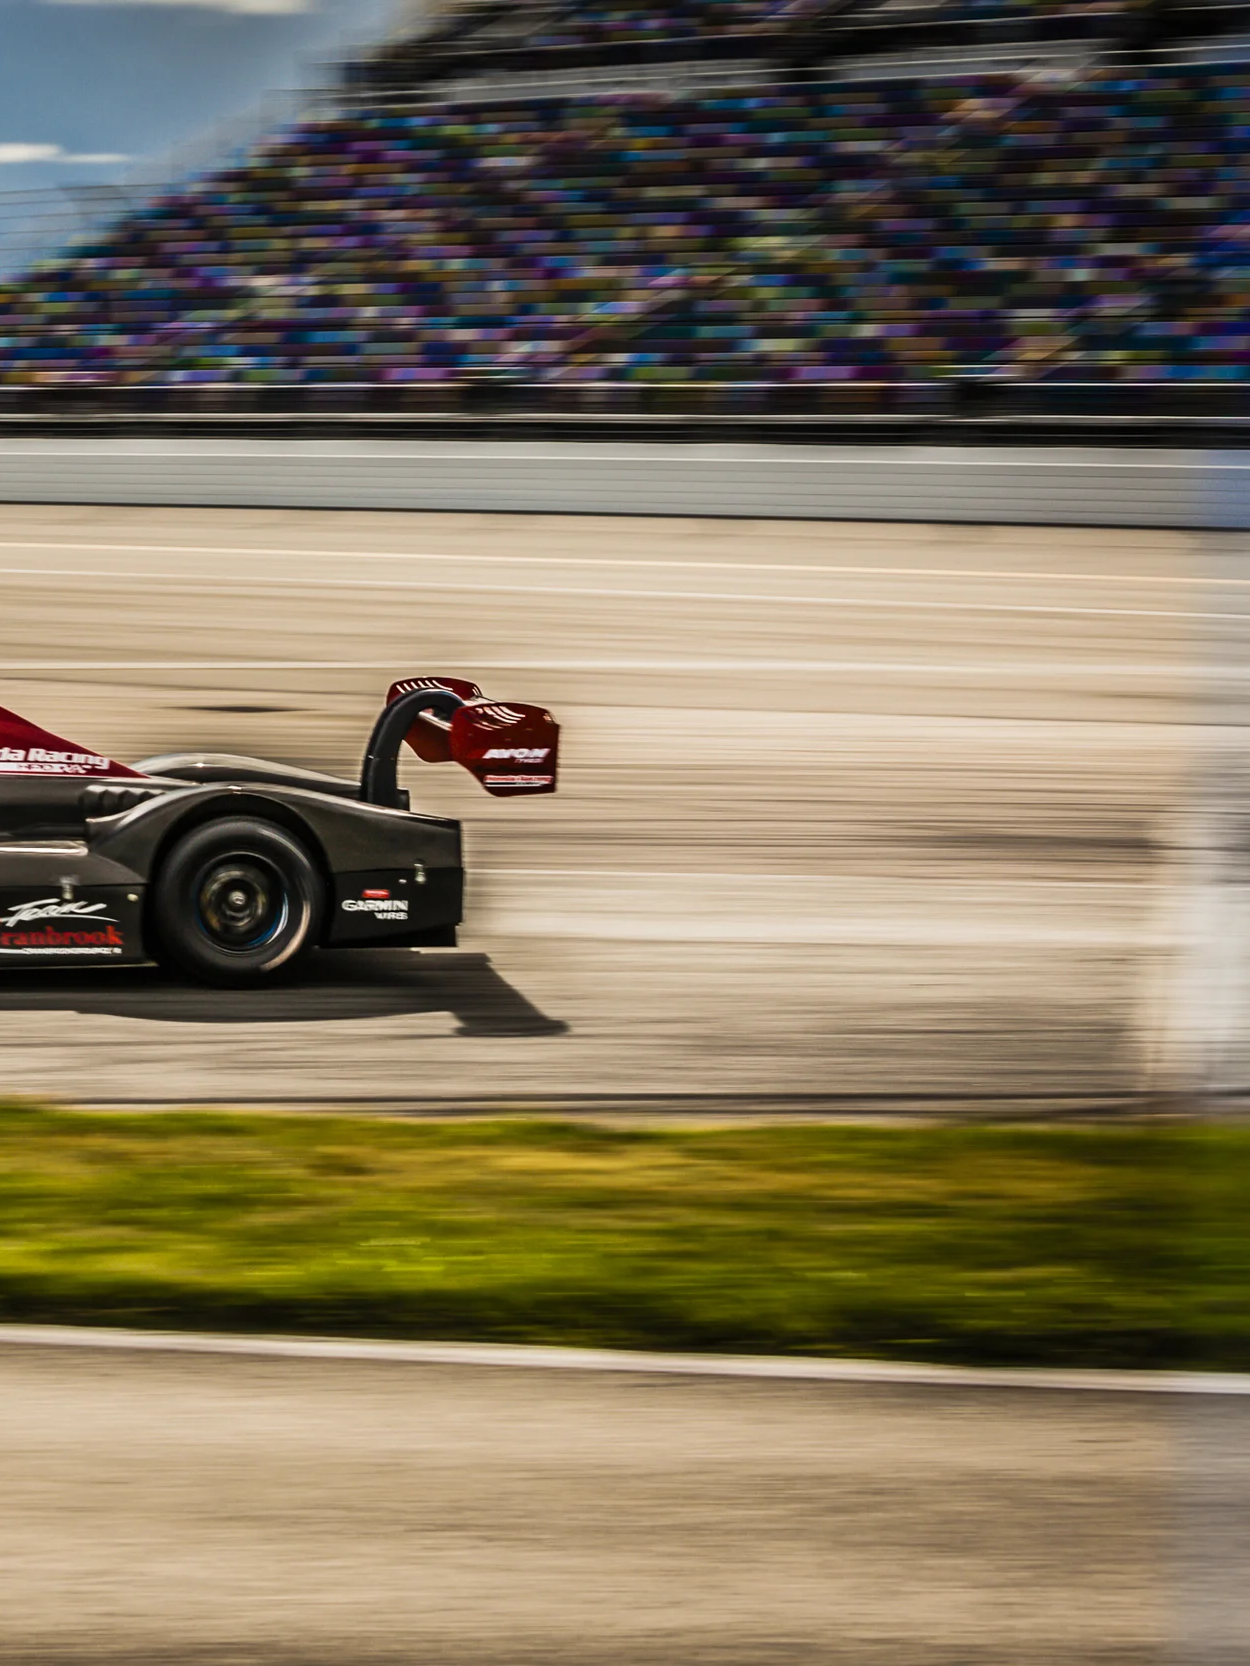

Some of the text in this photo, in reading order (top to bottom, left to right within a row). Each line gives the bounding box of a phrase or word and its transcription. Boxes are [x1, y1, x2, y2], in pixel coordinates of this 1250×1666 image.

[27, 747, 110, 770] Racing
[482, 748, 551, 759] AVON
[341, 900, 409, 911] GARMIN
